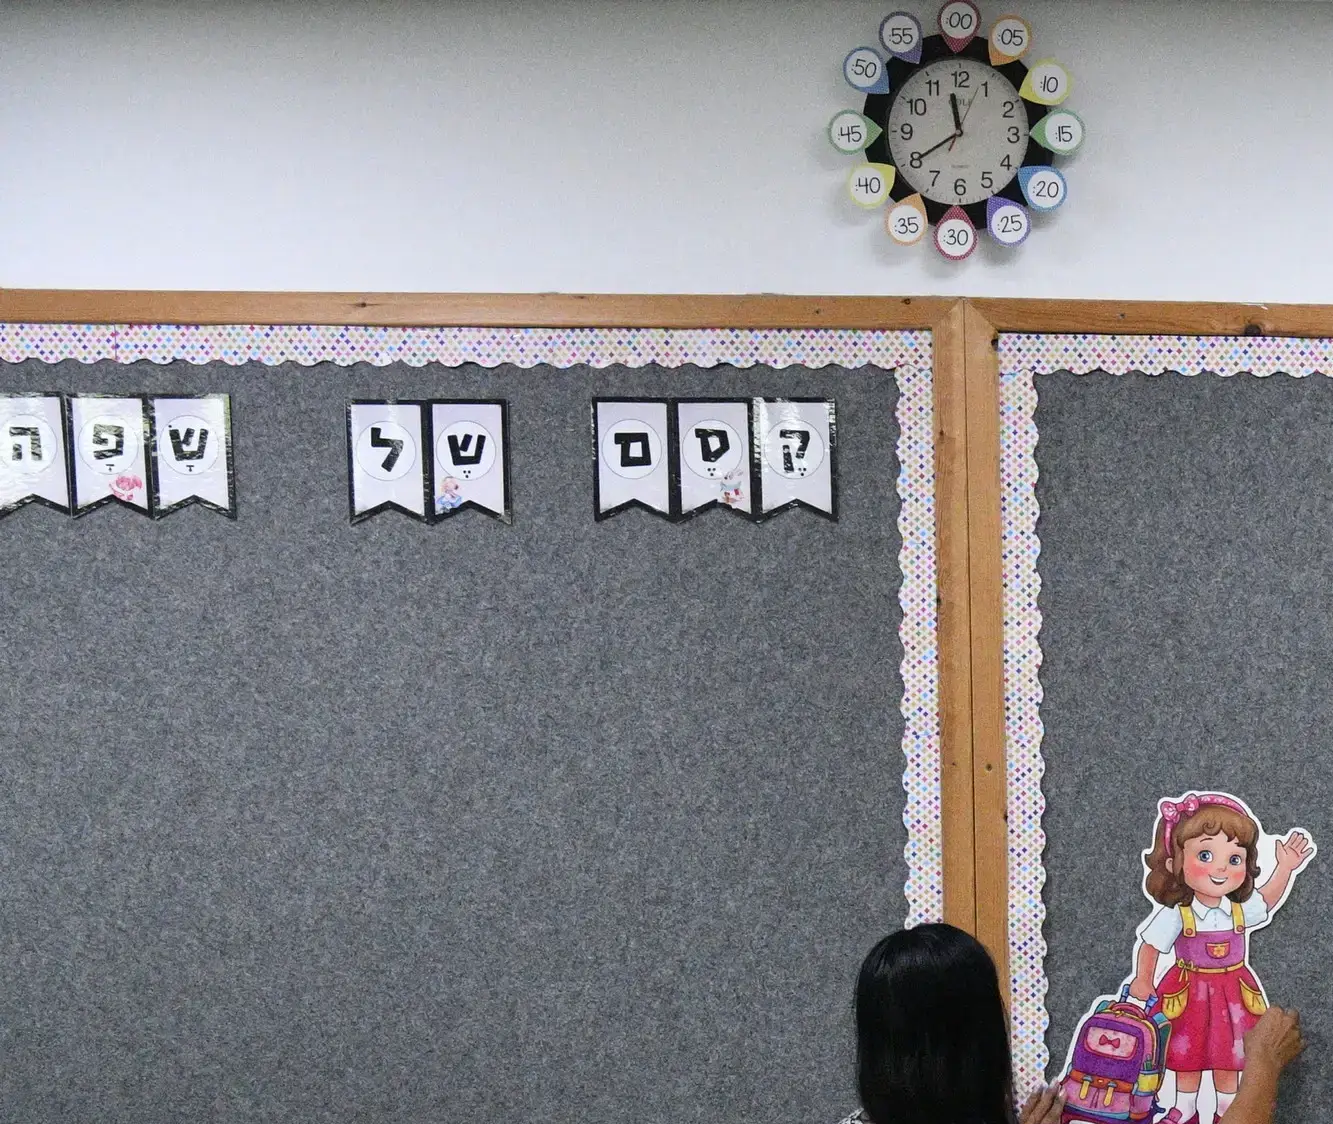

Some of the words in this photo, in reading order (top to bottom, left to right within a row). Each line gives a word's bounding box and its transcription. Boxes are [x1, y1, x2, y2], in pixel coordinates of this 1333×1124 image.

[925, 80, 940, 96] 11
[951, 71, 970, 88] 12
[981, 82, 988, 97] 1
[909, 98, 927, 116] 10
[1002, 101, 1014, 118] 2
[901, 123, 913, 140] 9
[1007, 126, 1020, 143] 3
[910, 152, 922, 168] 8
[1000, 154, 1012, 171] 4
[929, 170, 940, 187] 7
[954, 178, 966, 195] 6
[981, 171, 993, 189] 5
